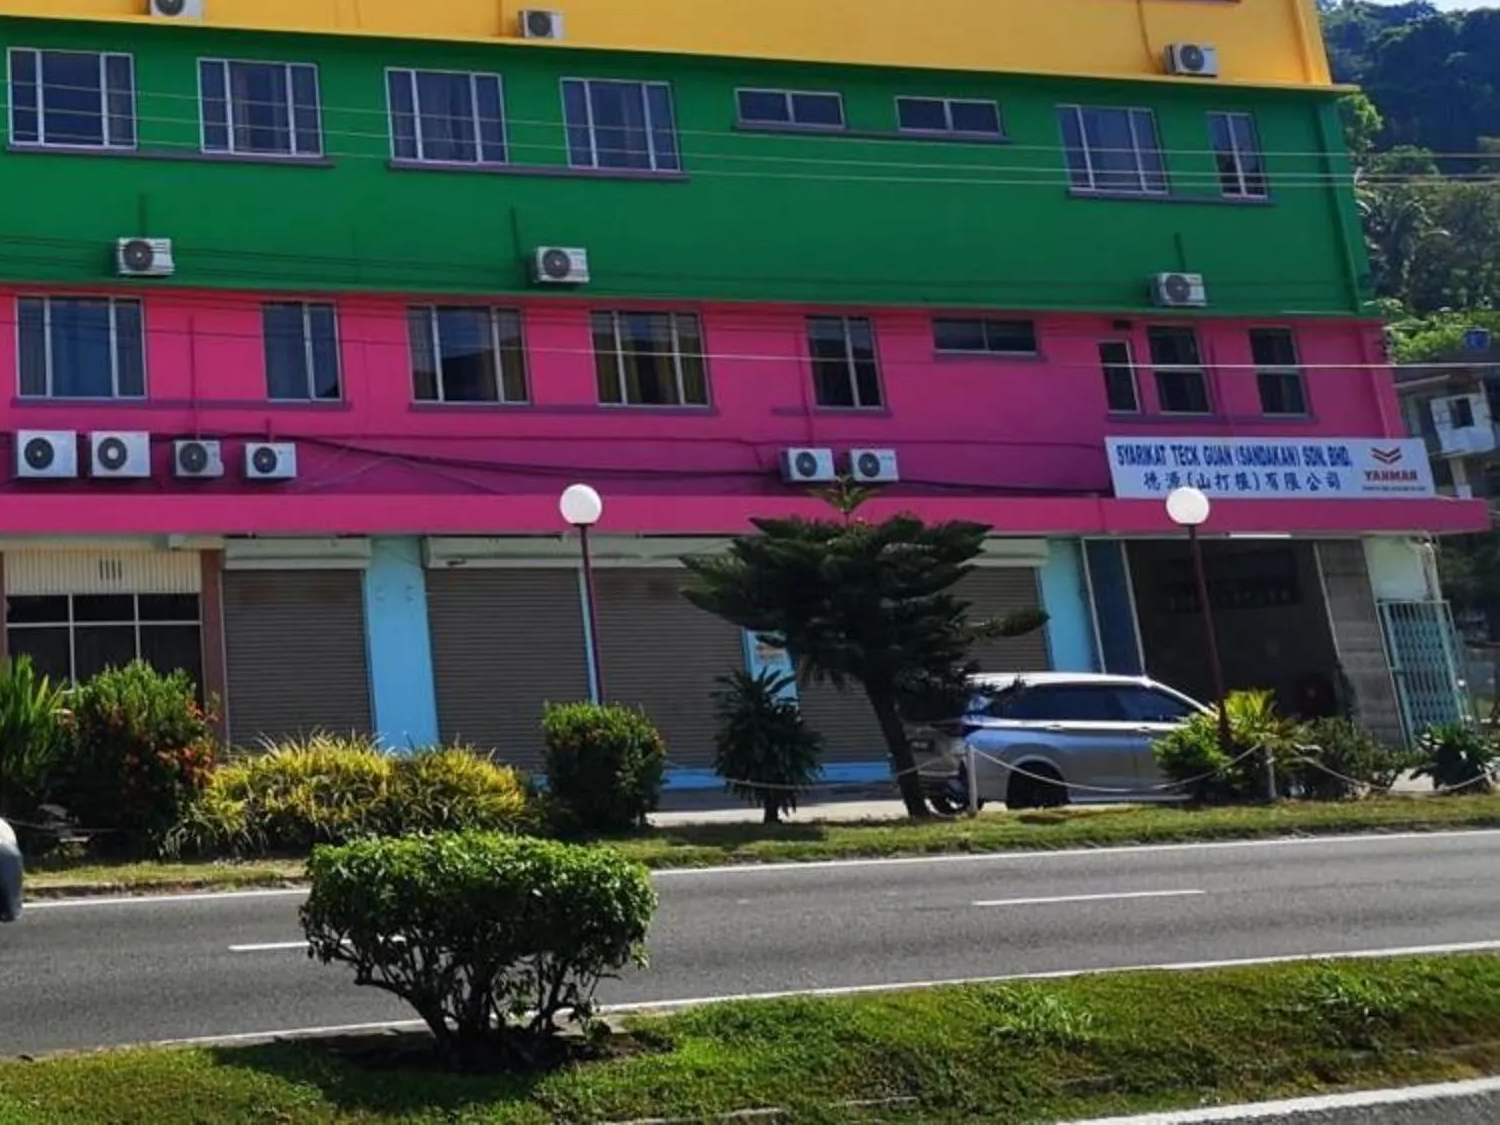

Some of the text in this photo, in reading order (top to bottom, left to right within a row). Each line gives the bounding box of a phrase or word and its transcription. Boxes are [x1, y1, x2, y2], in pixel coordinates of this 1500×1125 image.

[1116, 444, 1167, 466] SYARIKAT
[1169, 444, 1200, 466] TECK
[1203, 445, 1234, 466] GUAN
[1364, 470, 1418, 481] YANMAR
